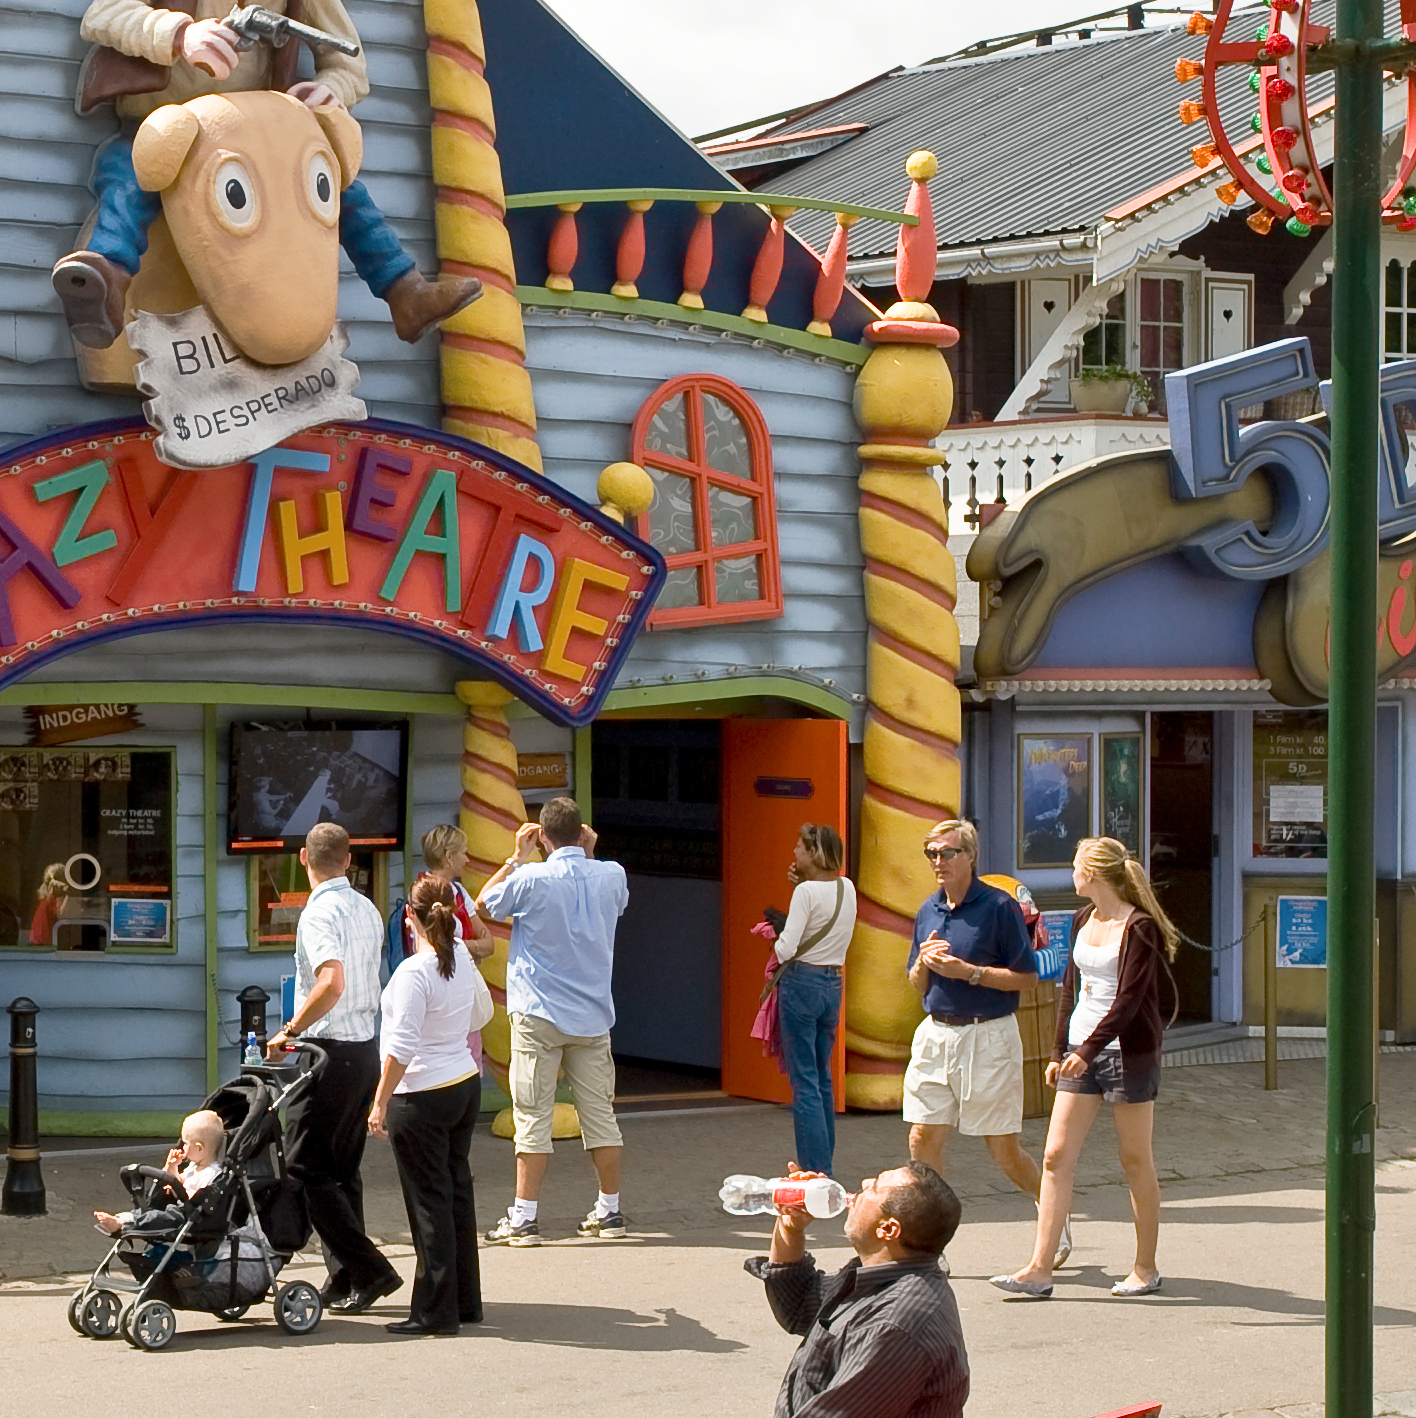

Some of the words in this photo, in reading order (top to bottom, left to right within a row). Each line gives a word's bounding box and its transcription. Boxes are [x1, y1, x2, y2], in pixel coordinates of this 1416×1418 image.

[233, 446, 630, 682] THEATRE
[38, 702, 129, 731] INDGANG
[516, 763, 560, 777] DGANG
[100, 808, 127, 818] CRAZY
[128, 808, 162, 818] THEATRE
